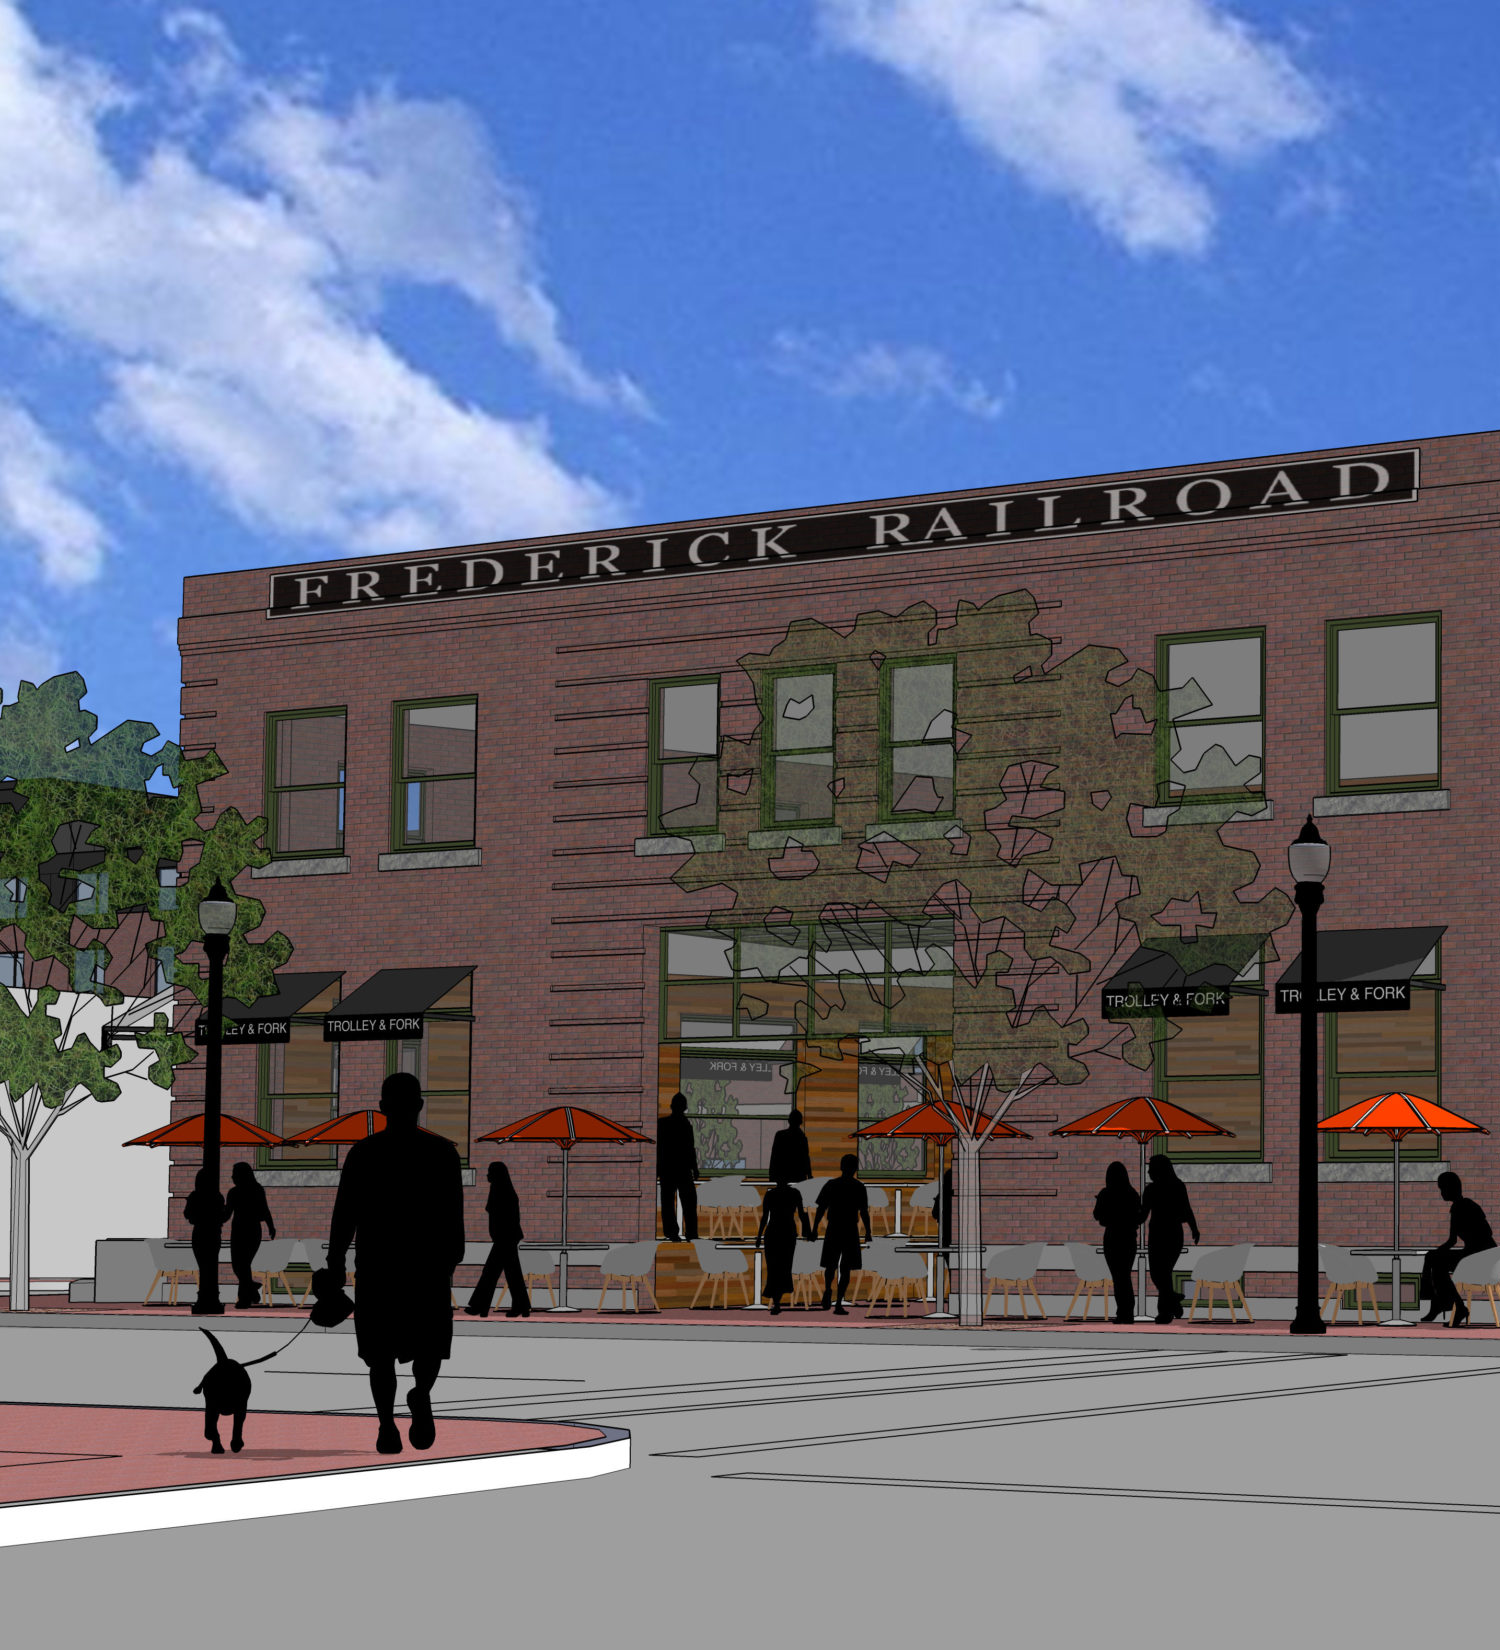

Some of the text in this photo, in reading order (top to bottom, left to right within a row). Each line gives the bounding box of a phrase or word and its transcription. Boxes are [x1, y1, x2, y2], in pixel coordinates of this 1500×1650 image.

[290, 462, 1390, 610] FREDERICK RAILROAD
[1106, 993, 1169, 1007] TROLLEY
[1186, 991, 1225, 1006] FORK
[1280, 985, 1406, 1002] TRLEY & FORK
[247, 1023, 255, 1035] &
[258, 1022, 288, 1035] FORK
[328, 1018, 421, 1032] TROLLEY & FORK
